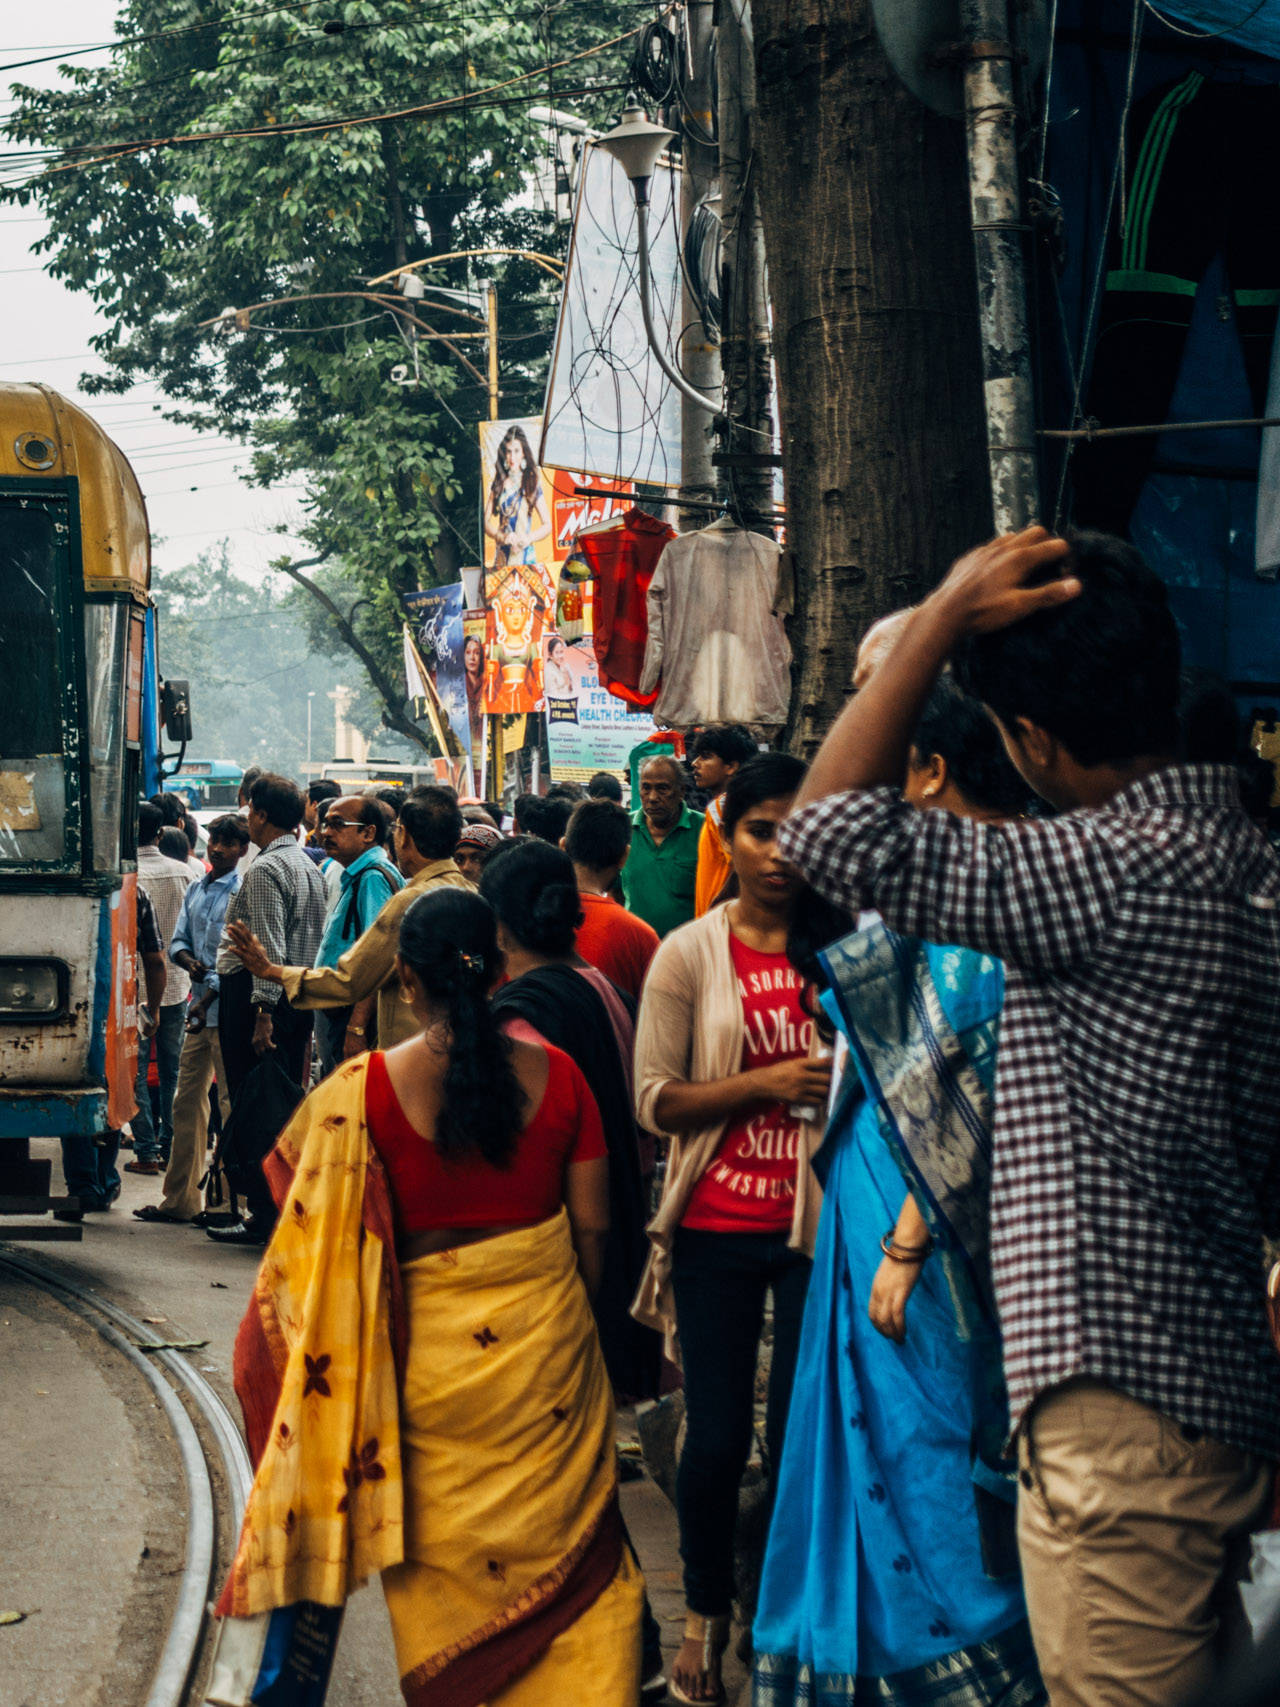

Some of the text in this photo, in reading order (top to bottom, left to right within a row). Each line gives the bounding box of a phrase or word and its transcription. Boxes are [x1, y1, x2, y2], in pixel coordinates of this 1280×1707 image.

[581, 676, 599, 688] BLO
[591, 692, 607, 704] EYE
[580, 709, 612, 721] HEALTH
[744, 1005, 814, 1055] Wha
[755, 1176, 795, 1200] HUN
